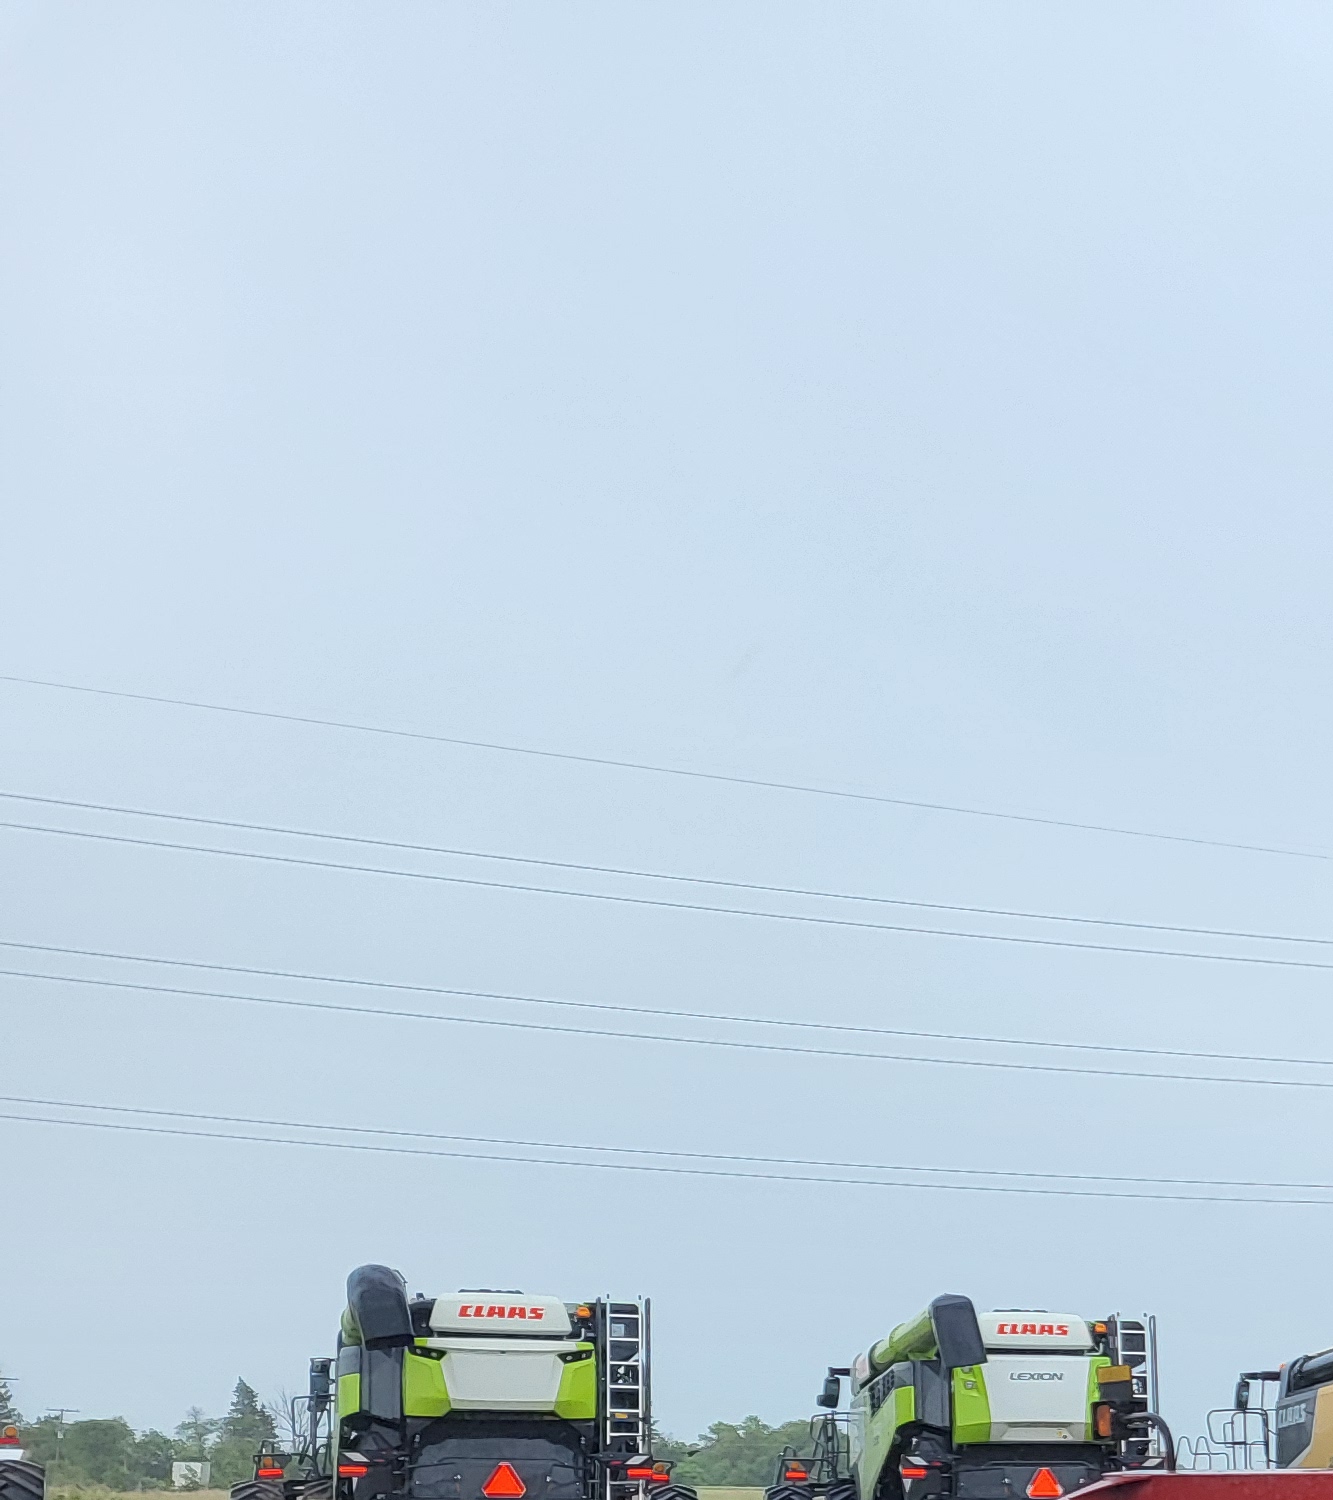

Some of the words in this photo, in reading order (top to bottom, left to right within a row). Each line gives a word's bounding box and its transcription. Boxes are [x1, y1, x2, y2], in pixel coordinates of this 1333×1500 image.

[458, 1305, 545, 1320] CLAAS
[997, 1323, 1069, 1336] CLAAS
[1010, 1372, 1064, 1381] LEXION
